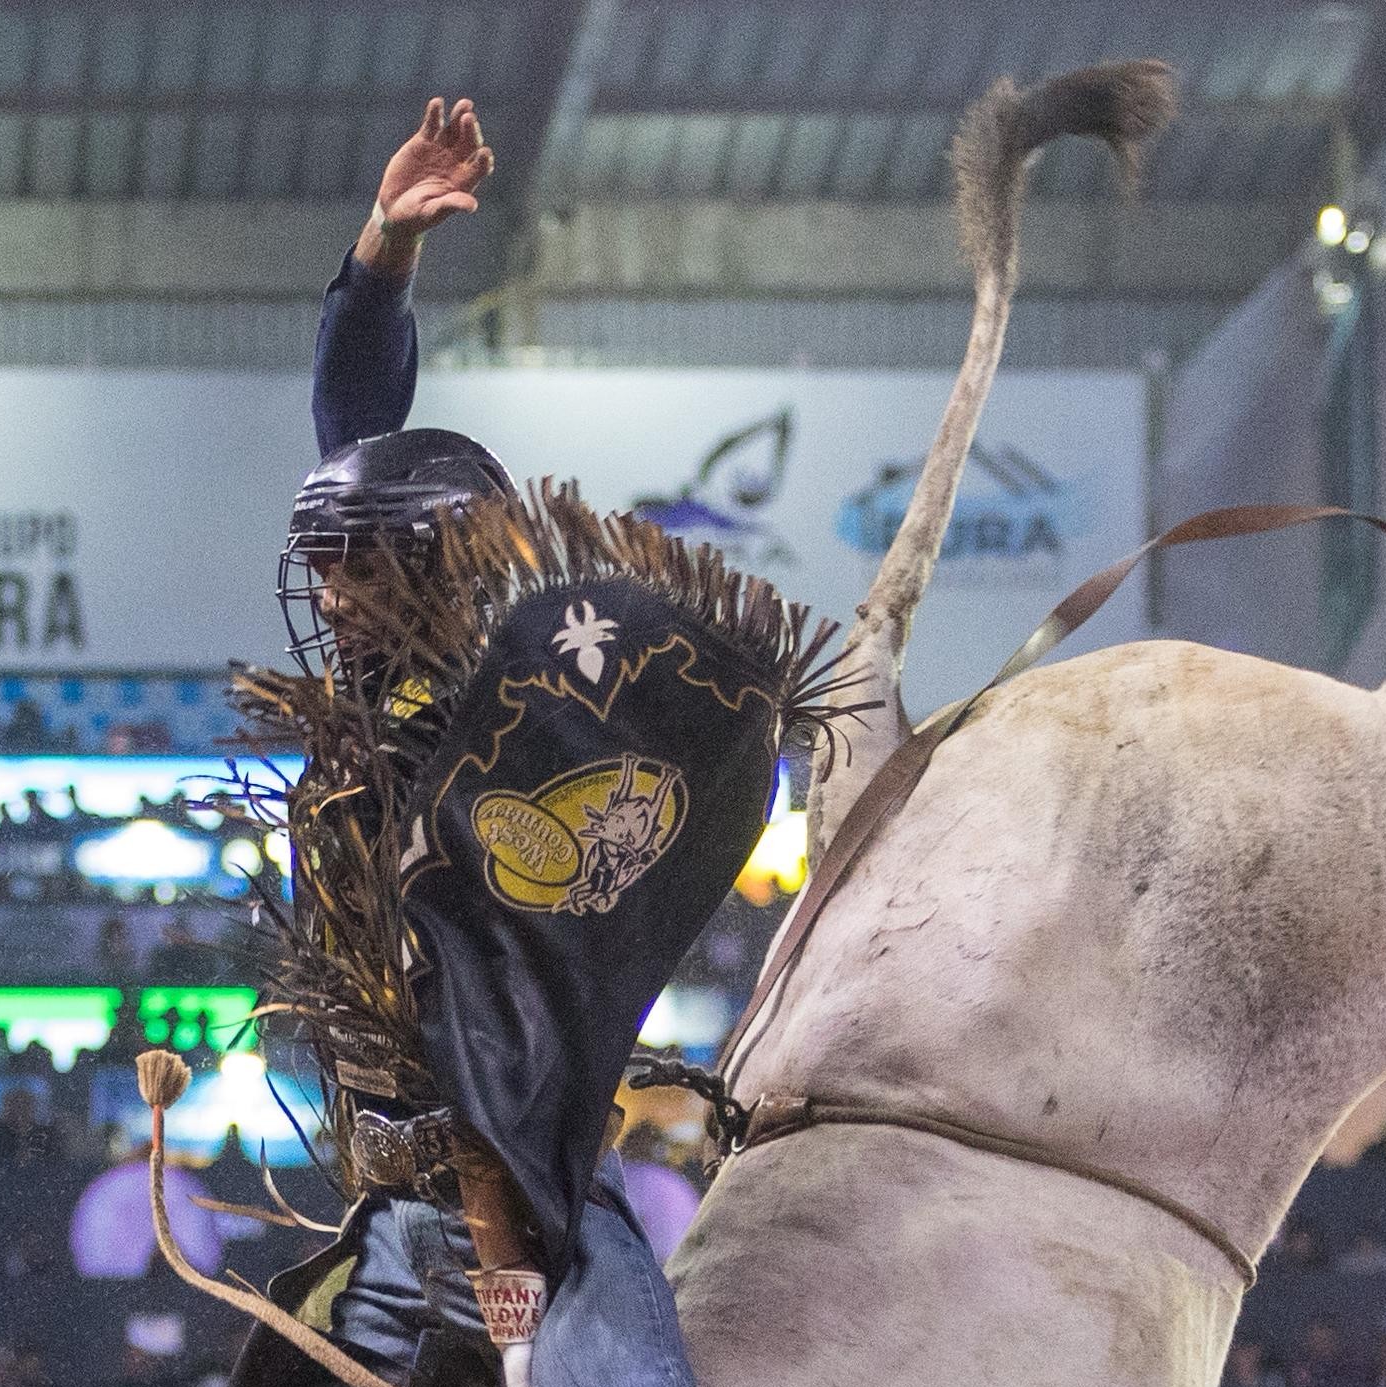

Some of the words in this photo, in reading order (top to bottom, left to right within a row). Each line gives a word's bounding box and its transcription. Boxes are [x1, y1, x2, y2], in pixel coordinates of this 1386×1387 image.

[478, 802, 573, 864] Country
[488, 822, 549, 877] West
[476, 1287, 542, 1307] TIFFANY
[492, 1326, 533, 1338] MPANY
